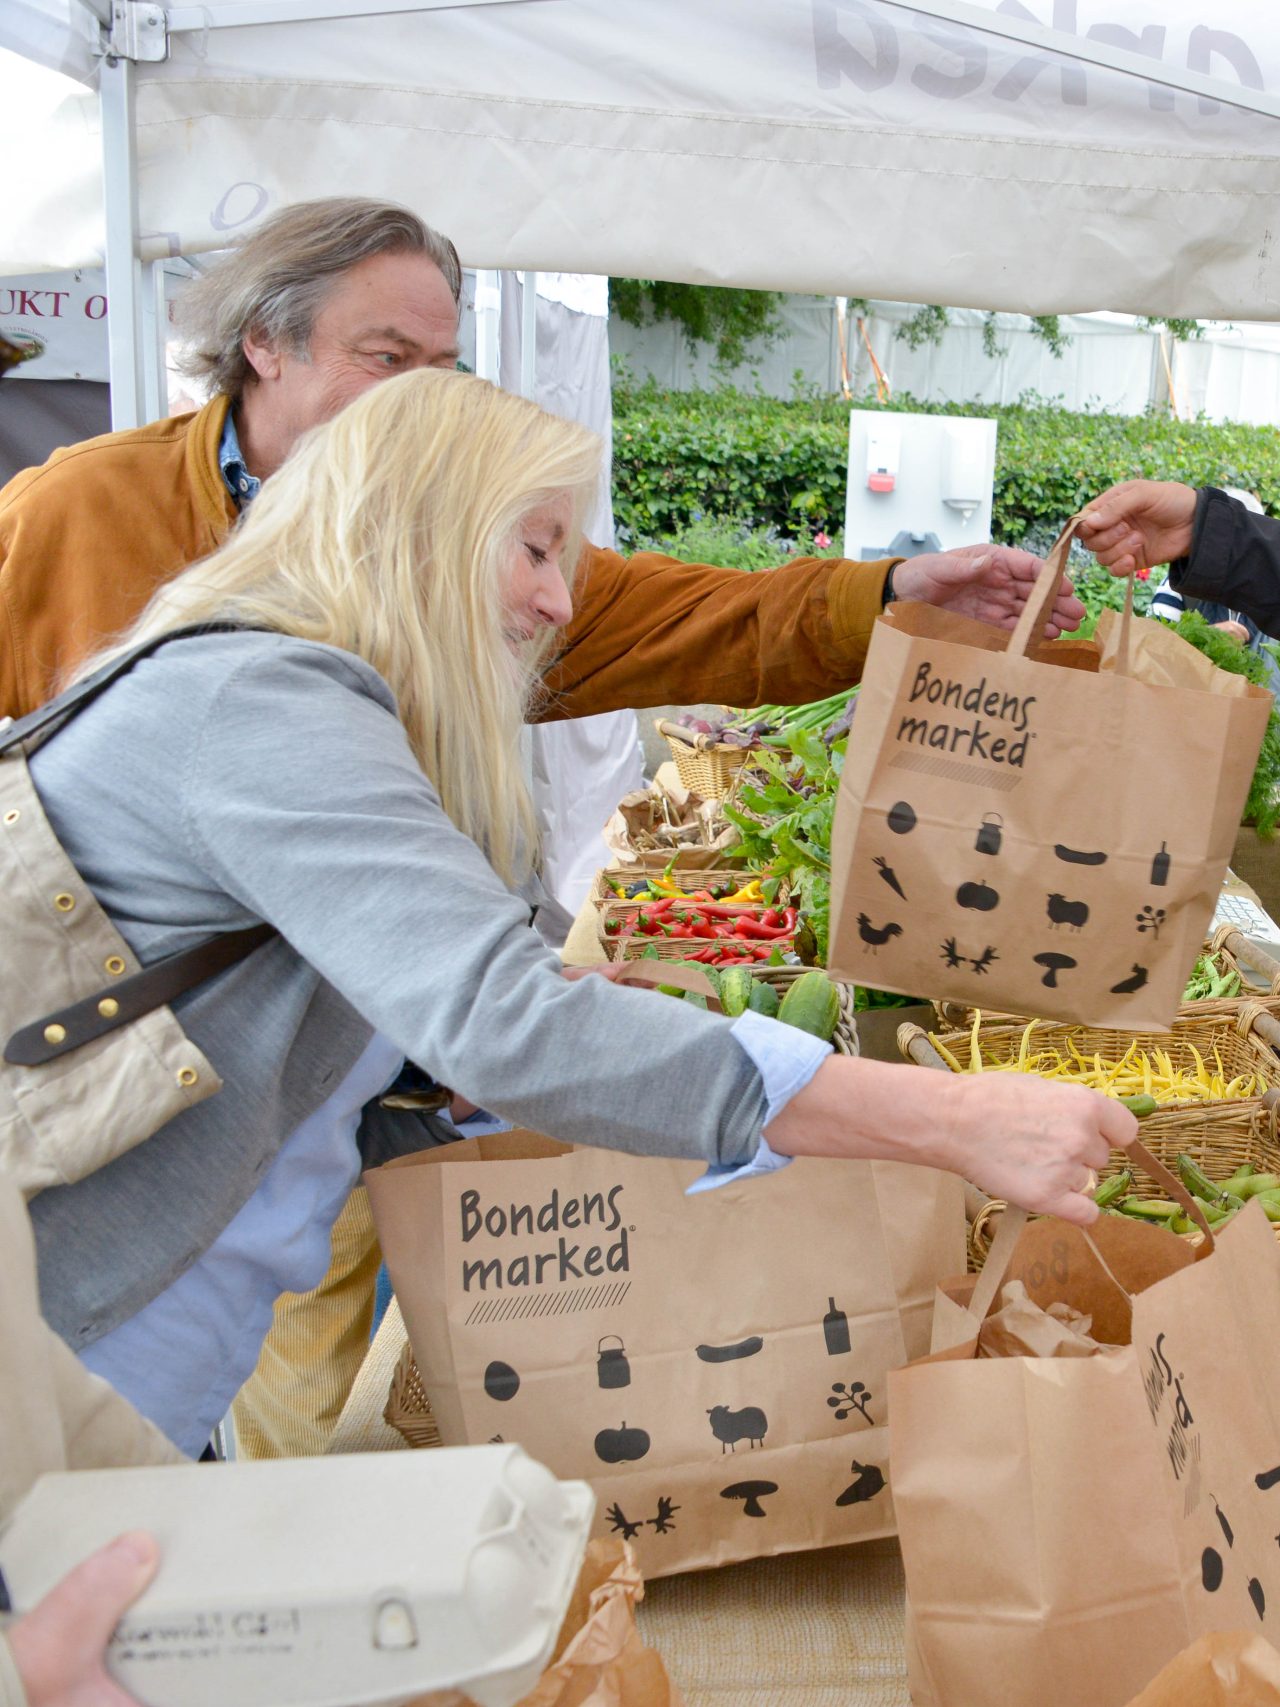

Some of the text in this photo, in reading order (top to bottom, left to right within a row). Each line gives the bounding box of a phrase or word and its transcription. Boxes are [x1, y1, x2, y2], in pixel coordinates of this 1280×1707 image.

[909, 661, 1037, 732] Bondens
[896, 716, 1029, 768] marked
[460, 1184, 625, 1243] Bondens
[463, 1227, 630, 1293] marked
